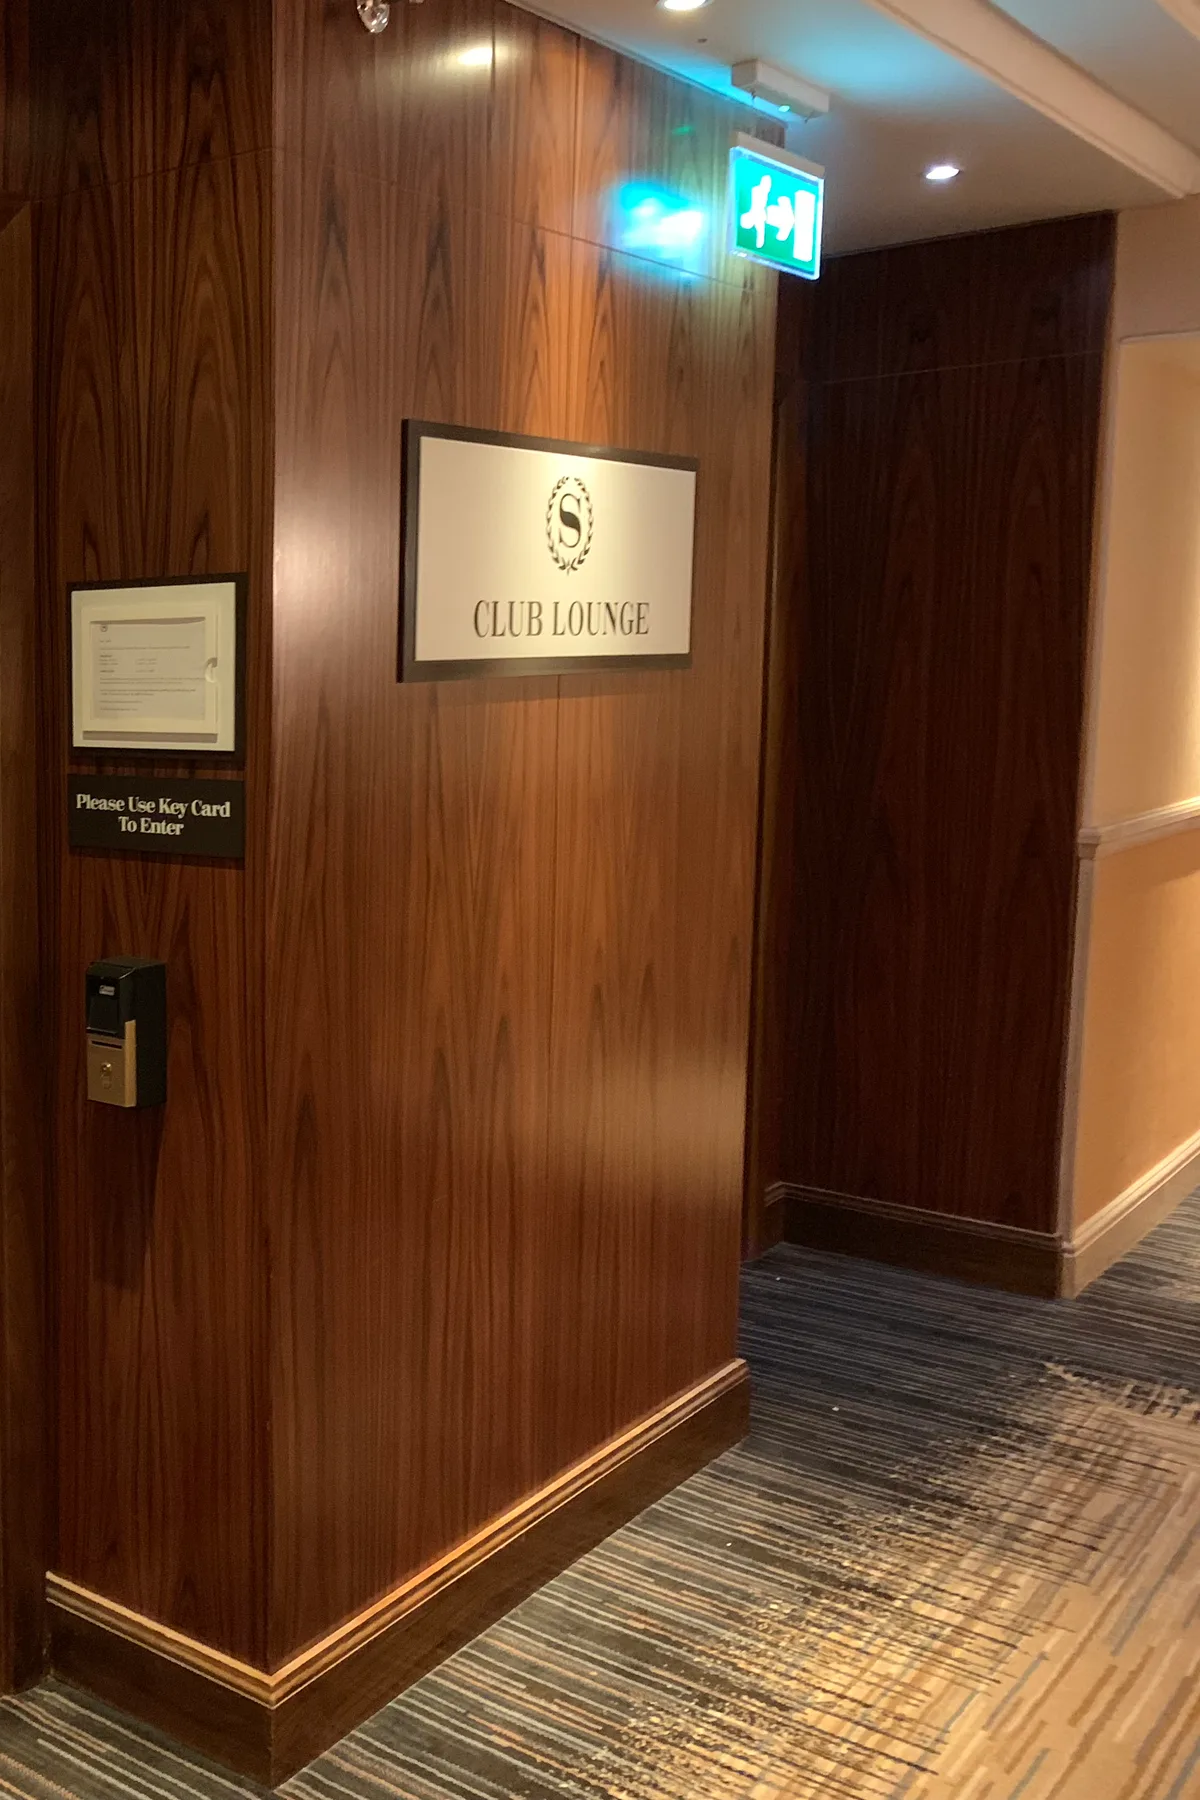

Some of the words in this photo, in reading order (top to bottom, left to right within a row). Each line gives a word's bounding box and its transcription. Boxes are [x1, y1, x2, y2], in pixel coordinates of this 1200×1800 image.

[473, 599, 543, 638] CLUB
[552, 600, 650, 637] LOUNGE
[76, 793, 125, 812] Please
[128, 796, 156, 814] Use
[158, 798, 189, 819] Key
[191, 799, 231, 818] Card
[118, 816, 137, 833] To
[139, 817, 185, 836] Enter
